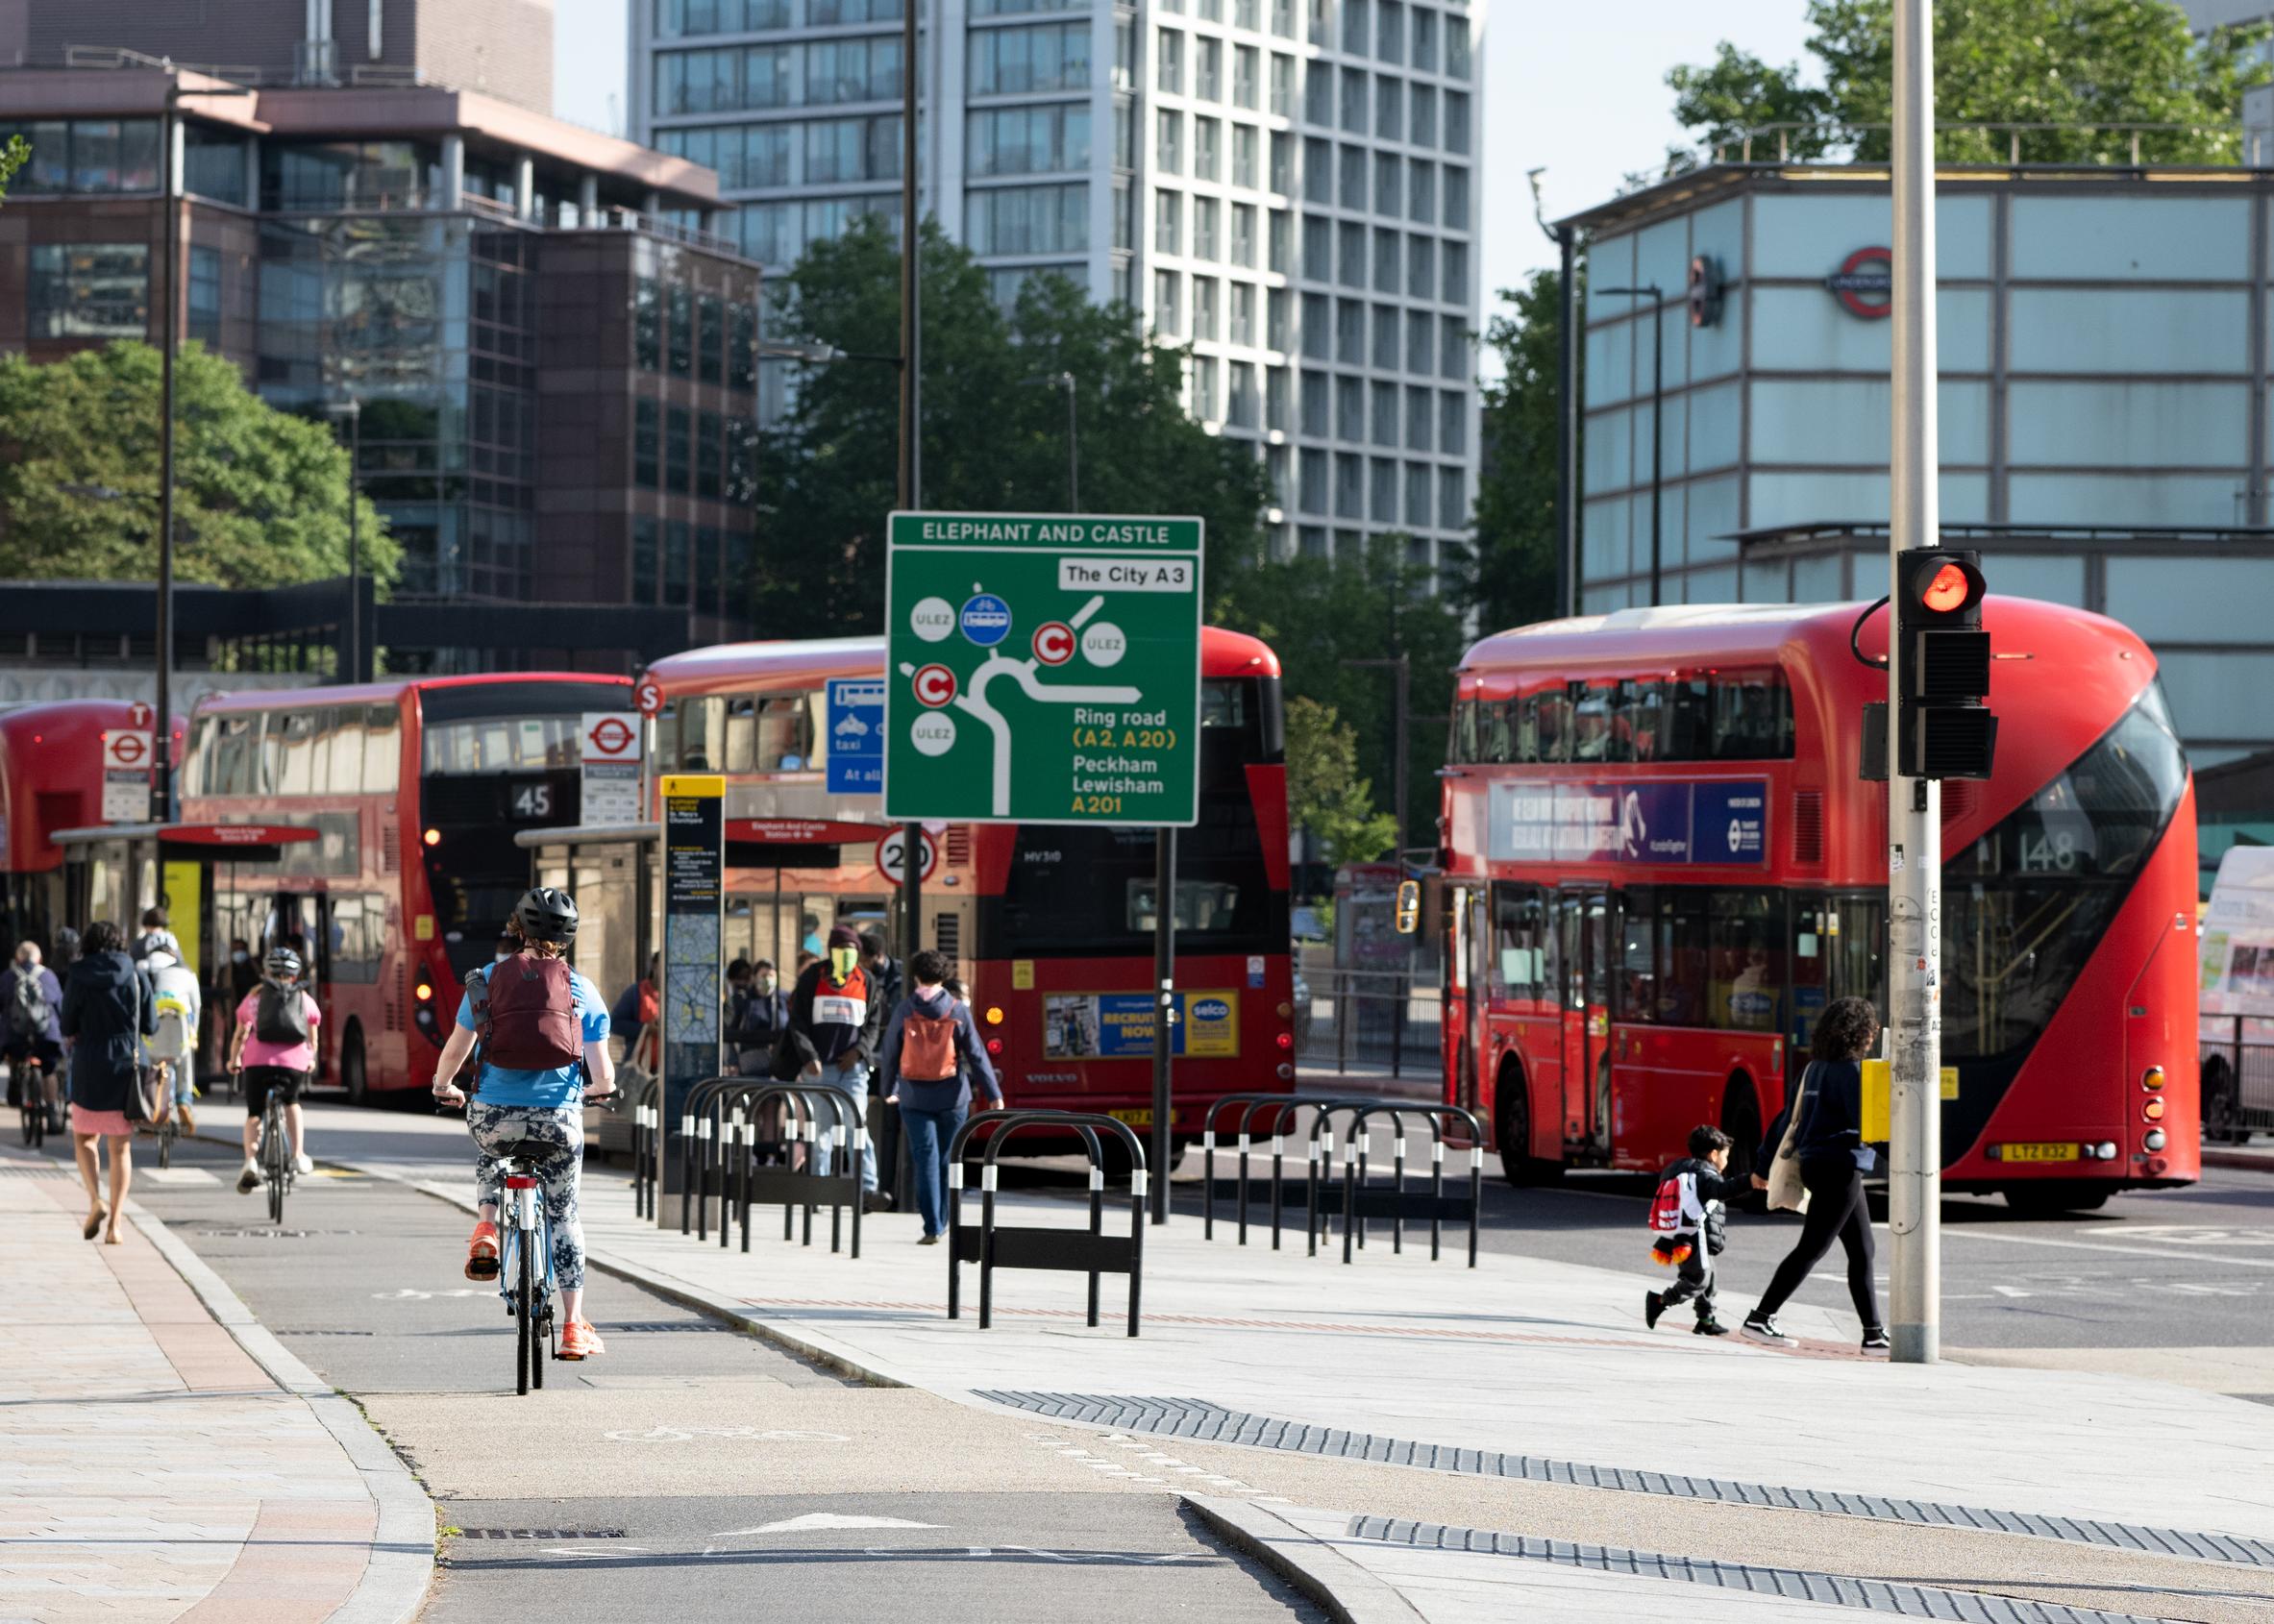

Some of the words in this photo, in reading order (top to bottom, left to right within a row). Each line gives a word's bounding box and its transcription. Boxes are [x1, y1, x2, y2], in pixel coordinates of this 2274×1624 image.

[923, 522, 1032, 541] ELEPHANT
[1038, 525, 1085, 542] AND
[1091, 526, 1170, 544] CASTLE
[1067, 565, 1101, 582] The
[1109, 567, 1149, 586] City
[1155, 568, 1185, 583] A3
[916, 613, 951, 626] ULEZ
[1087, 638, 1122, 651] ULEZ
[642, 686, 657, 710] S
[134, 706, 146, 726] T
[1075, 708, 1116, 727] Ring
[1123, 709, 1166, 726] road
[916, 727, 952, 740] ULEZ
[1123, 729, 1176, 750] A20)
[836, 739, 860, 751] taxi
[1074, 755, 1158, 774] Peckham
[845, 769, 860, 780] At
[1073, 775, 1164, 794] Lewisham
[515, 785, 550, 816] 45
[1072, 796, 1122, 814] A201
[752, 822, 784, 831] Elephant
[2020, 831, 2075, 872] 148
[1194, 1002, 1228, 1017] selco
[1026, 1073, 1077, 1083] VOLVO
[2013, 1144, 2039, 1159] LTZ
